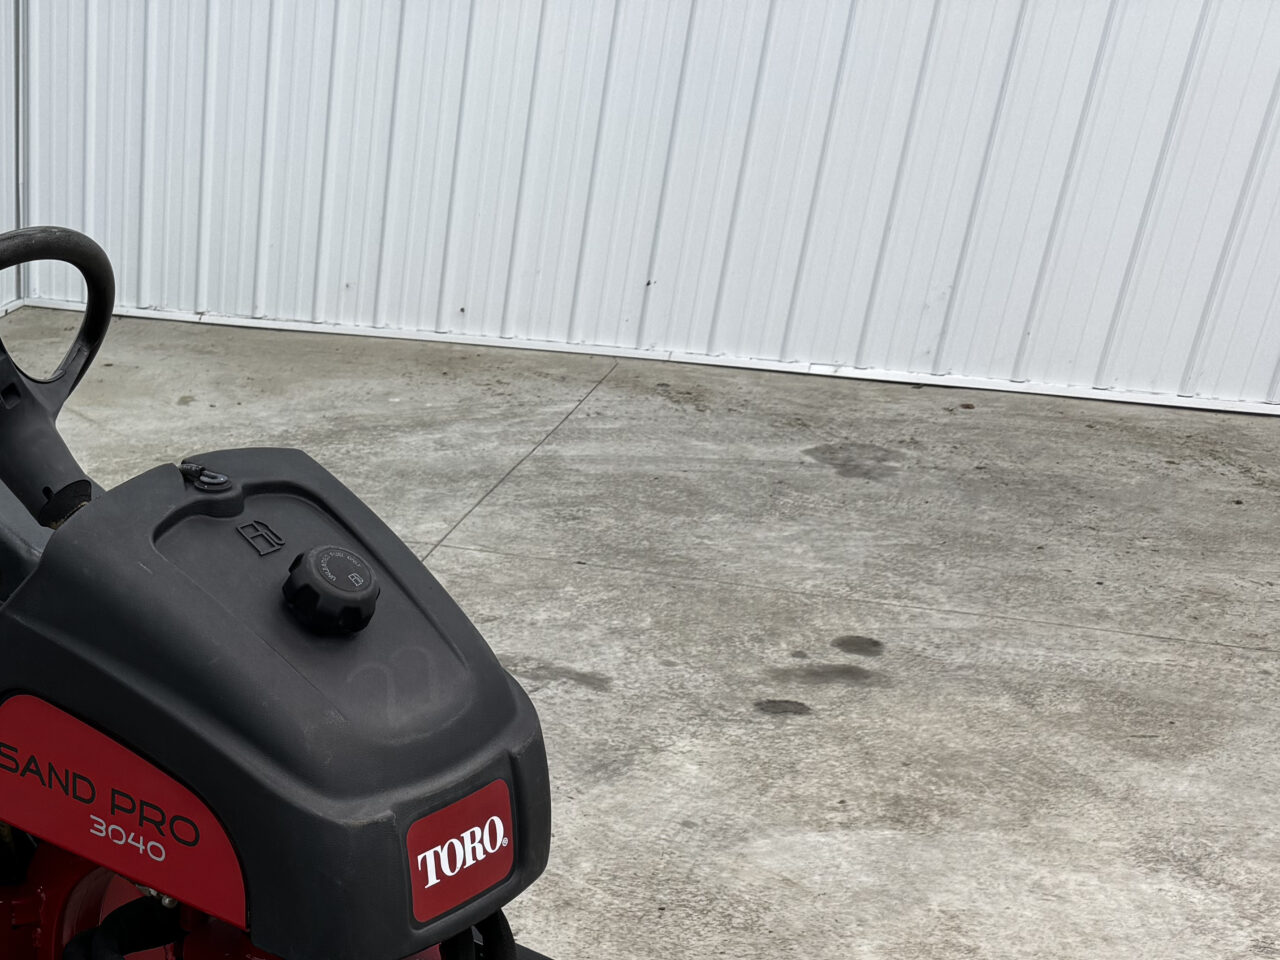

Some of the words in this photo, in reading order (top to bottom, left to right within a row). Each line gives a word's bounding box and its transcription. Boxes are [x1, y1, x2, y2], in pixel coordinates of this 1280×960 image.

[89, 814, 166, 862] 3040
[110, 788, 200, 847] PRO
[417, 815, 505, 889] TORO
